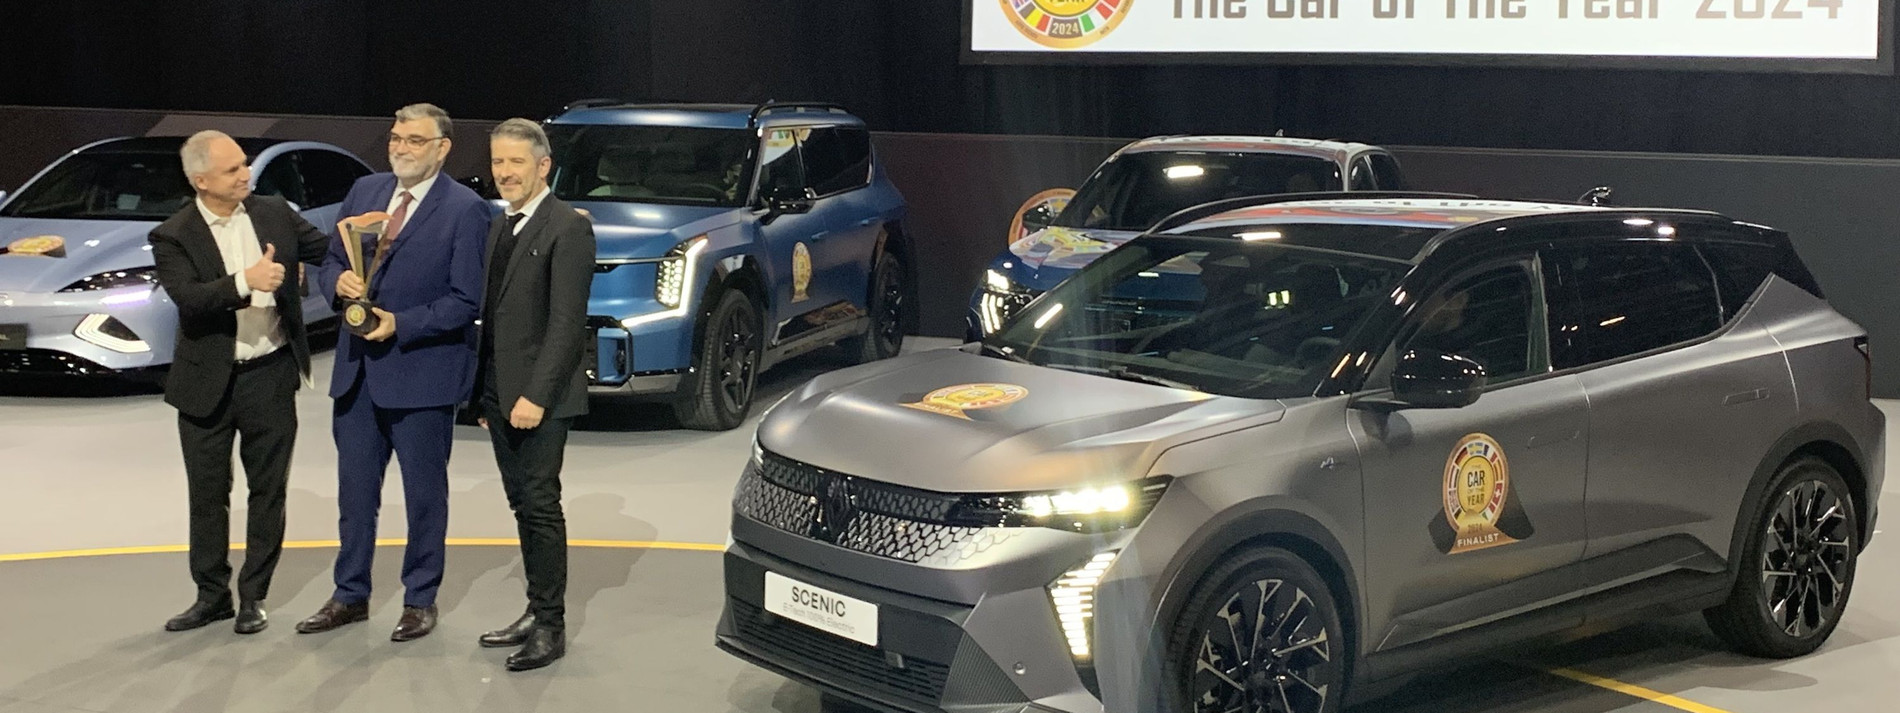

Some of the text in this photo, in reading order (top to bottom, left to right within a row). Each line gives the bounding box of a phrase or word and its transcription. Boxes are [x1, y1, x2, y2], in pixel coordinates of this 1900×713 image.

[1051, 22, 1079, 35] 2024
[1467, 470, 1486, 488] CAR
[1467, 493, 1485, 506] YEAR
[1457, 533, 1500, 547] FINALIST
[791, 586, 846, 618] SCENIC
